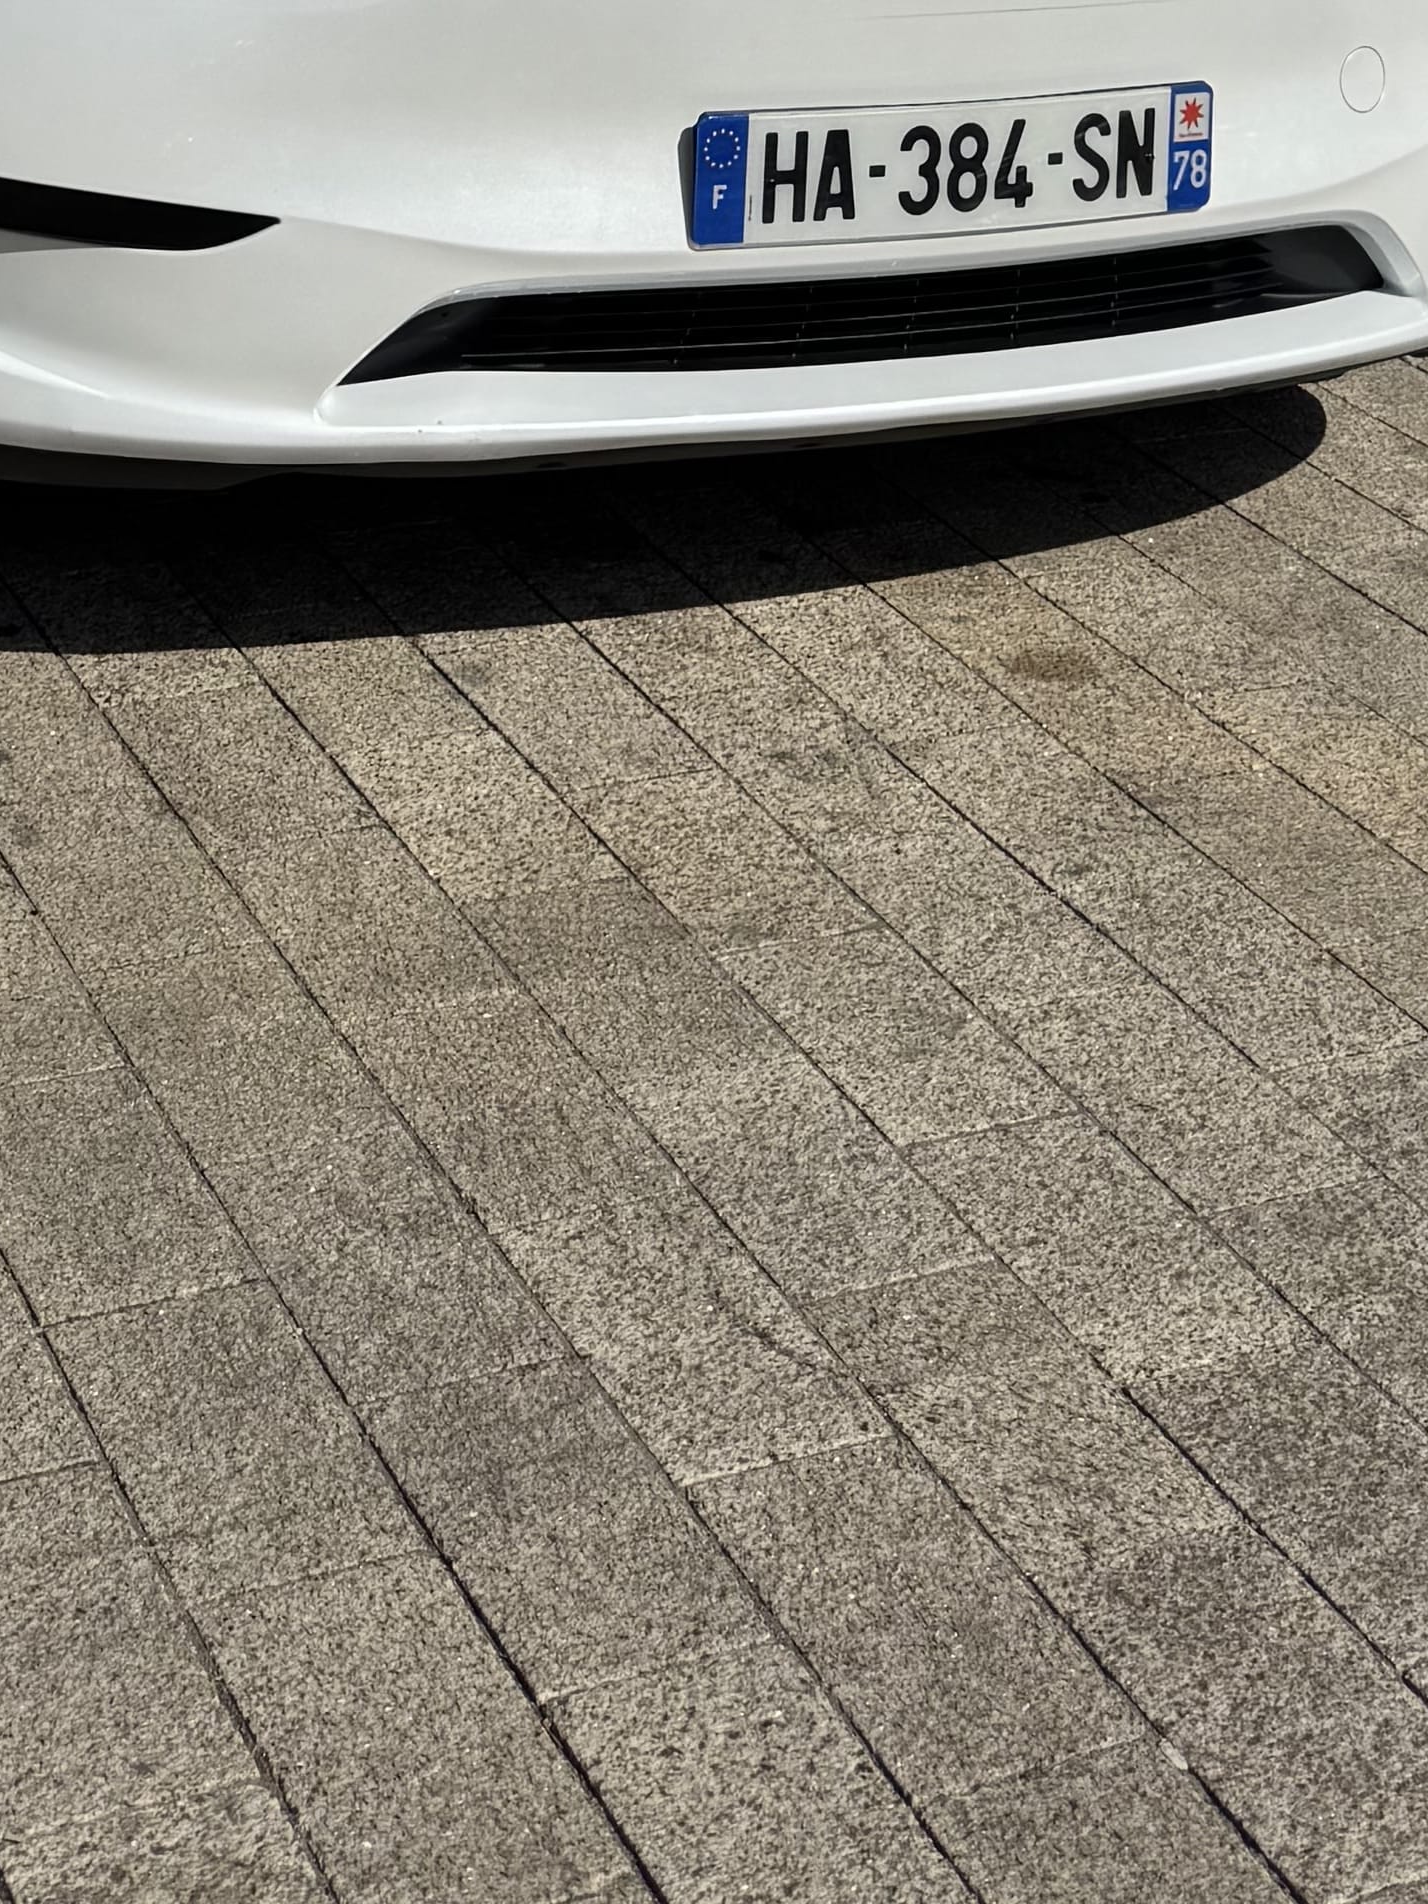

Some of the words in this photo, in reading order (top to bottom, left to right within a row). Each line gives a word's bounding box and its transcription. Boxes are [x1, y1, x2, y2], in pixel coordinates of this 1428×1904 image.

[711, 184, 728, 210] F
[761, 107, 1156, 224] HA-384-SN
[1172, 148, 1208, 191] 78
